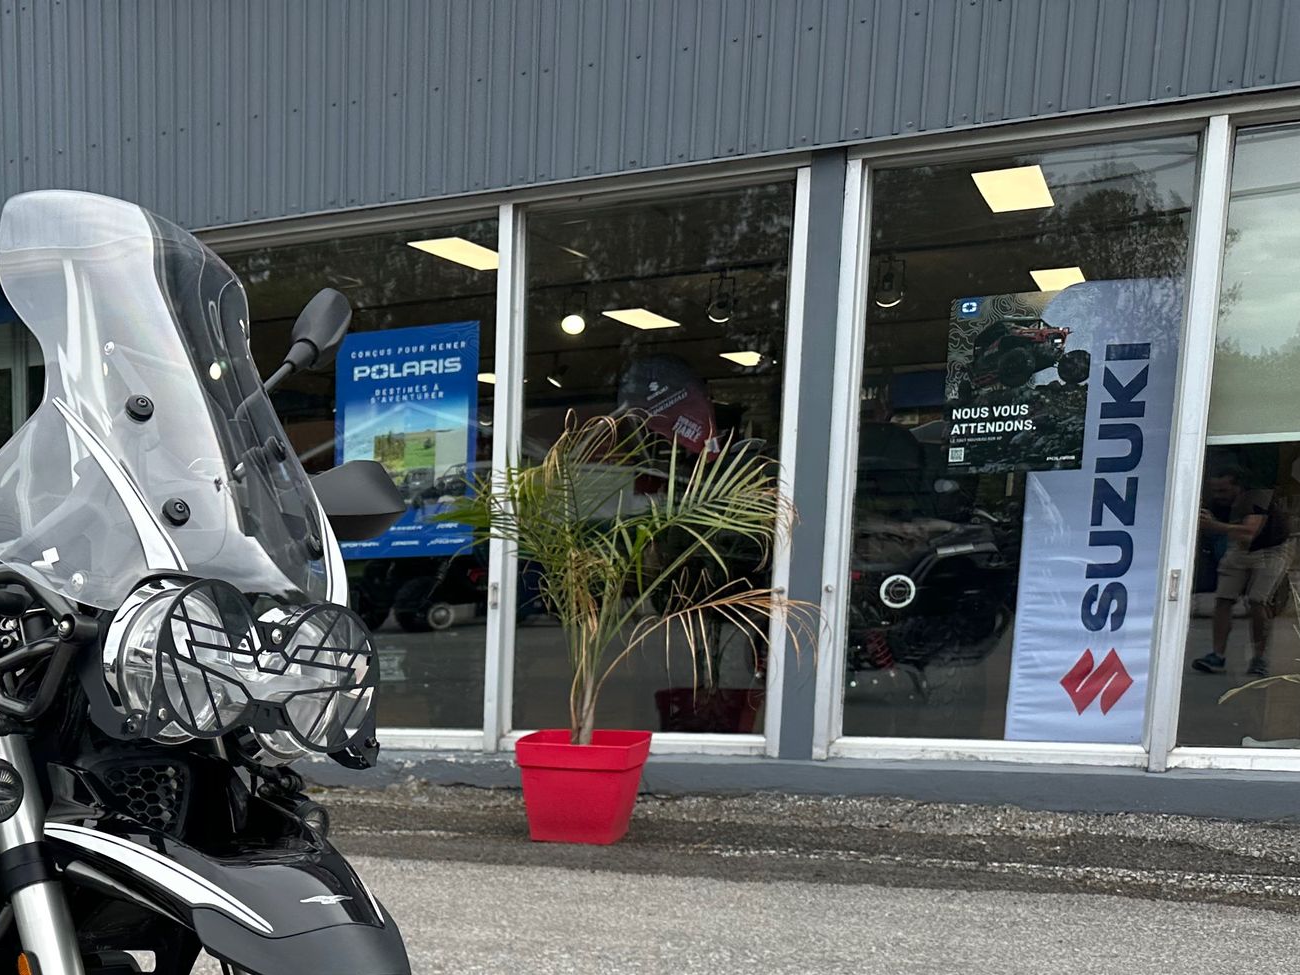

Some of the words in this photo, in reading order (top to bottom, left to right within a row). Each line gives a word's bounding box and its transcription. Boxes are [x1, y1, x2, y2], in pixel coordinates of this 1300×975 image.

[350, 347, 393, 359] CONÇUS
[397, 344, 425, 355] POUR
[430, 340, 467, 352] MENER
[353, 356, 462, 382] POLARIS
[952, 406, 989, 420] NOUS
[992, 404, 1029, 417] VOUS
[950, 419, 1037, 436] ATTENDONS.
[1081, 342, 1151, 633] SUZUKI
